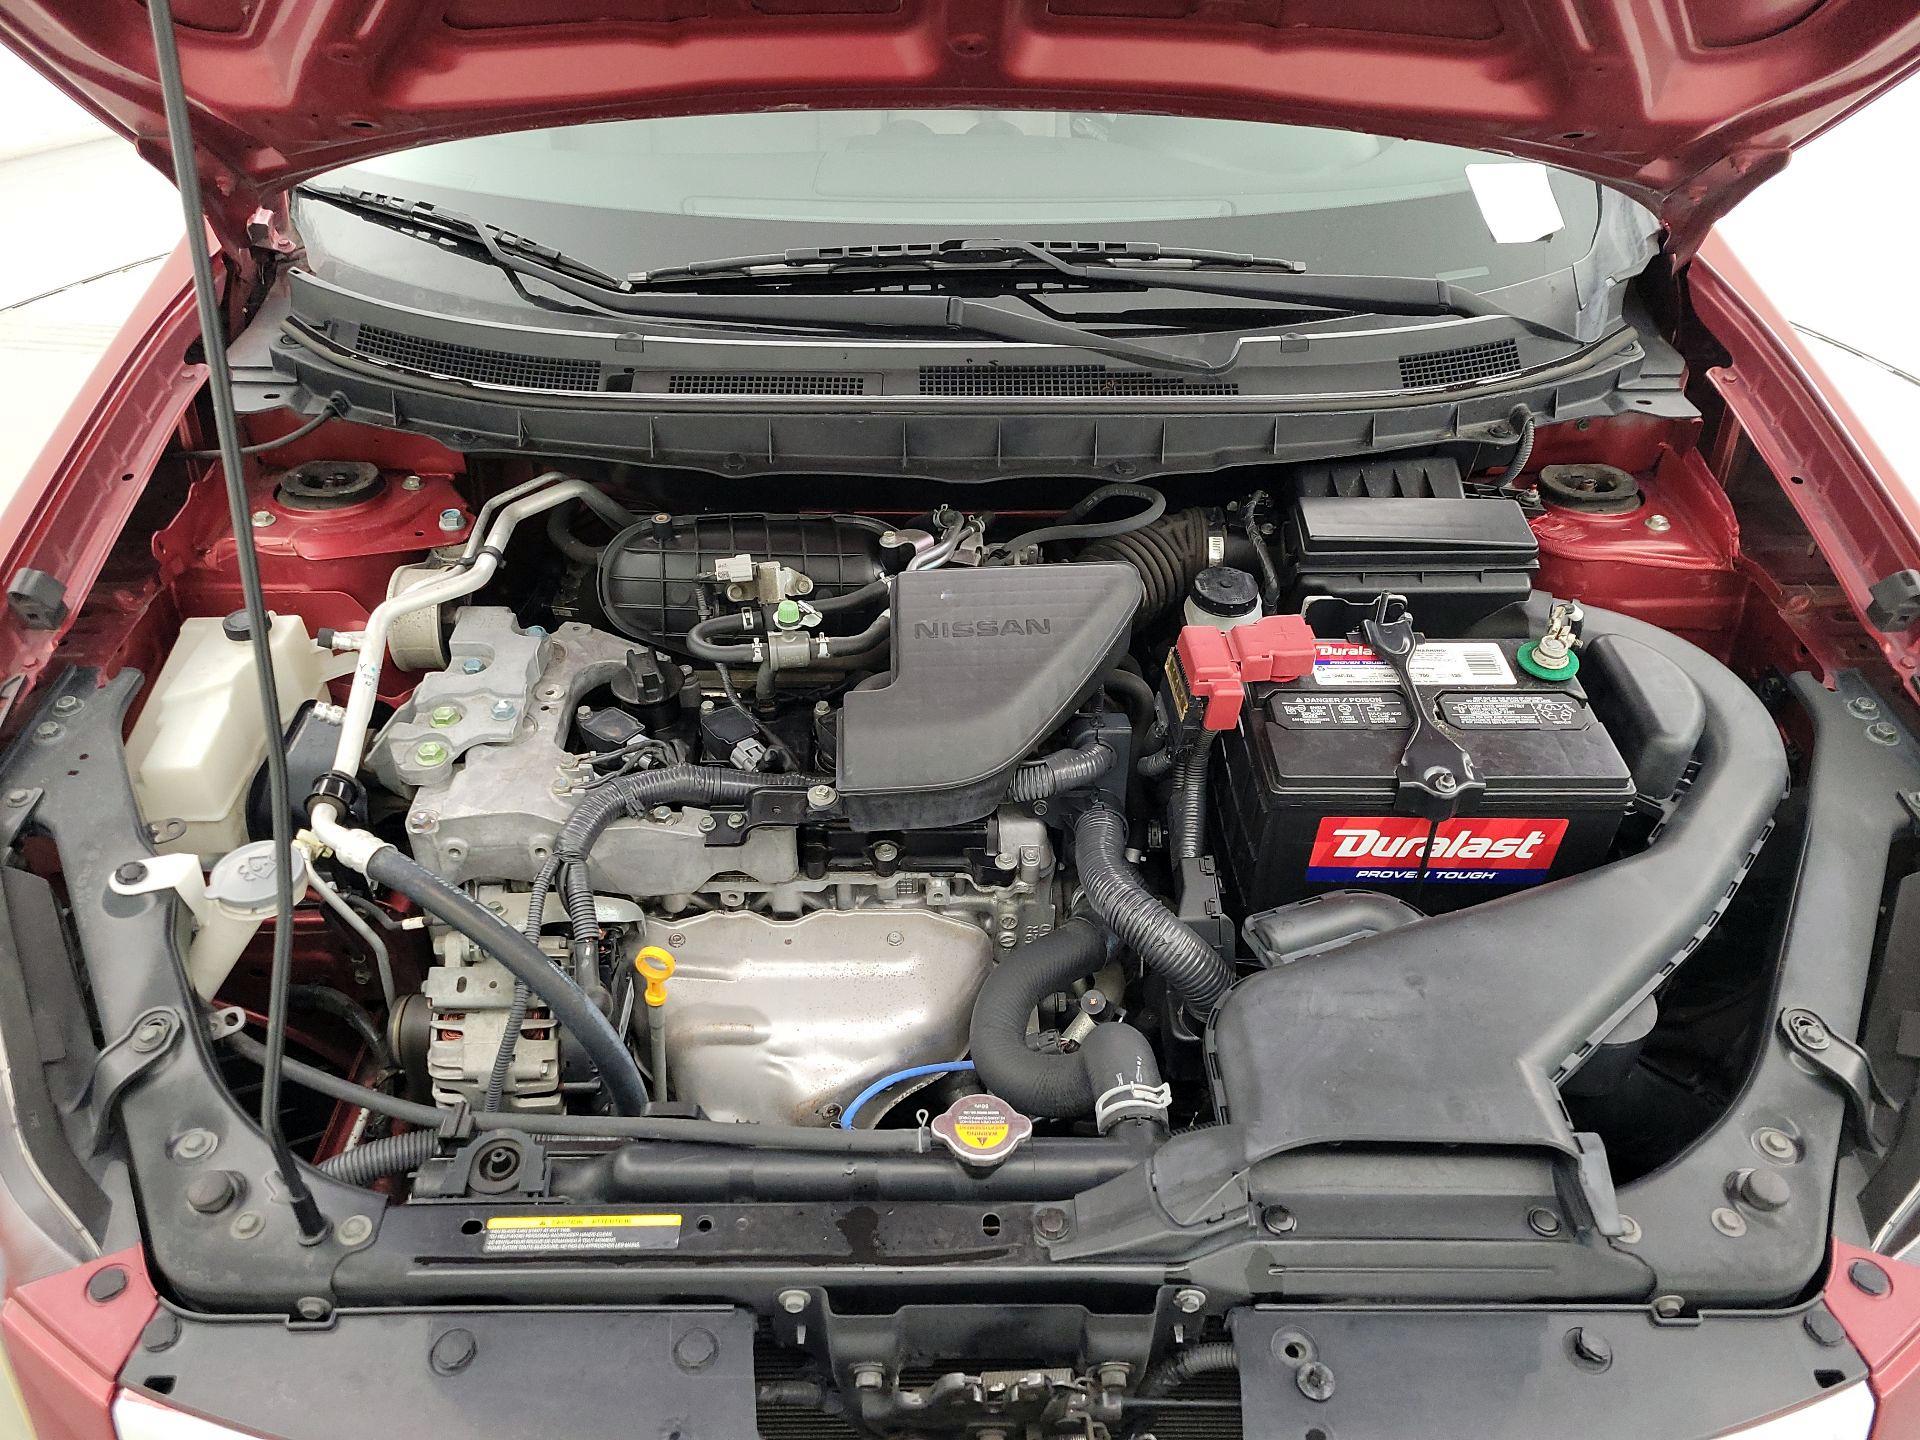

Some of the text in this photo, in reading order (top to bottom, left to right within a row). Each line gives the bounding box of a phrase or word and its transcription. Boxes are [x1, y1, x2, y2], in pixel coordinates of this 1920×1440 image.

[914, 618, 1051, 640] NISSAN
[1315, 645, 1376, 656] Durala
[1333, 828, 1544, 860] Duralast
[1436, 871, 1496, 880] TOUGH
